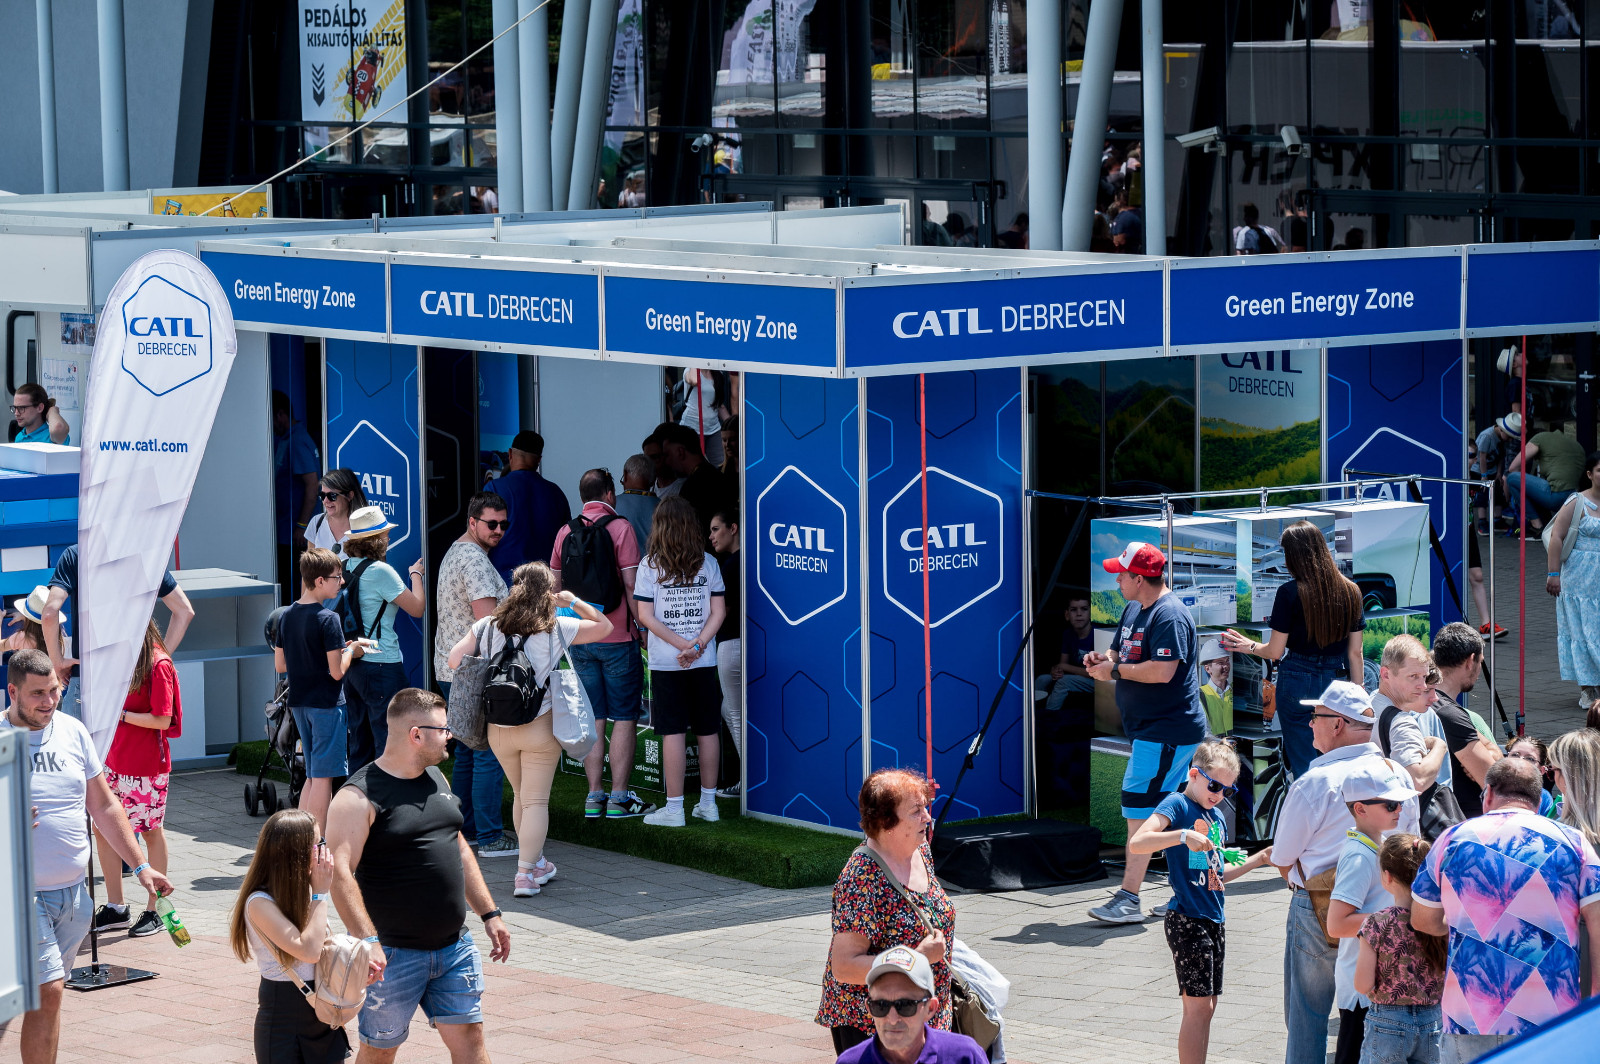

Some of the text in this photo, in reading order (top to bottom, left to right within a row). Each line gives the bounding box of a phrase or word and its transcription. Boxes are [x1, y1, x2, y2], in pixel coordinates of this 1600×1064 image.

[305, 3, 367, 27] PEDÁLOS
[307, 29, 349, 47] KISAUTÓ
[357, 70, 367, 82] 20
[234, 279, 356, 310] Green Energy Zone
[1225, 288, 1415, 318] Green Energy Zone
[420, 290, 573, 324] CATL DEBRECEN
[129, 316, 204, 338] CATL
[645, 307, 798, 342] Green Energy Zone
[892, 299, 1125, 339] CATL DEBRECEN
[137, 342, 197, 356] DEBRECEN
[1228, 376, 1294, 398] DEBRECEN
[99, 438, 188, 453] www.catl.com
[353, 471, 400, 497] ATL
[769, 522, 835, 553] CATL
[900, 523, 993, 551] CATL
[775, 552, 829, 574] DEBRECEN
[909, 552, 979, 574] DEBRECEN
[667, 587, 702, 596] AUTHENTIC
